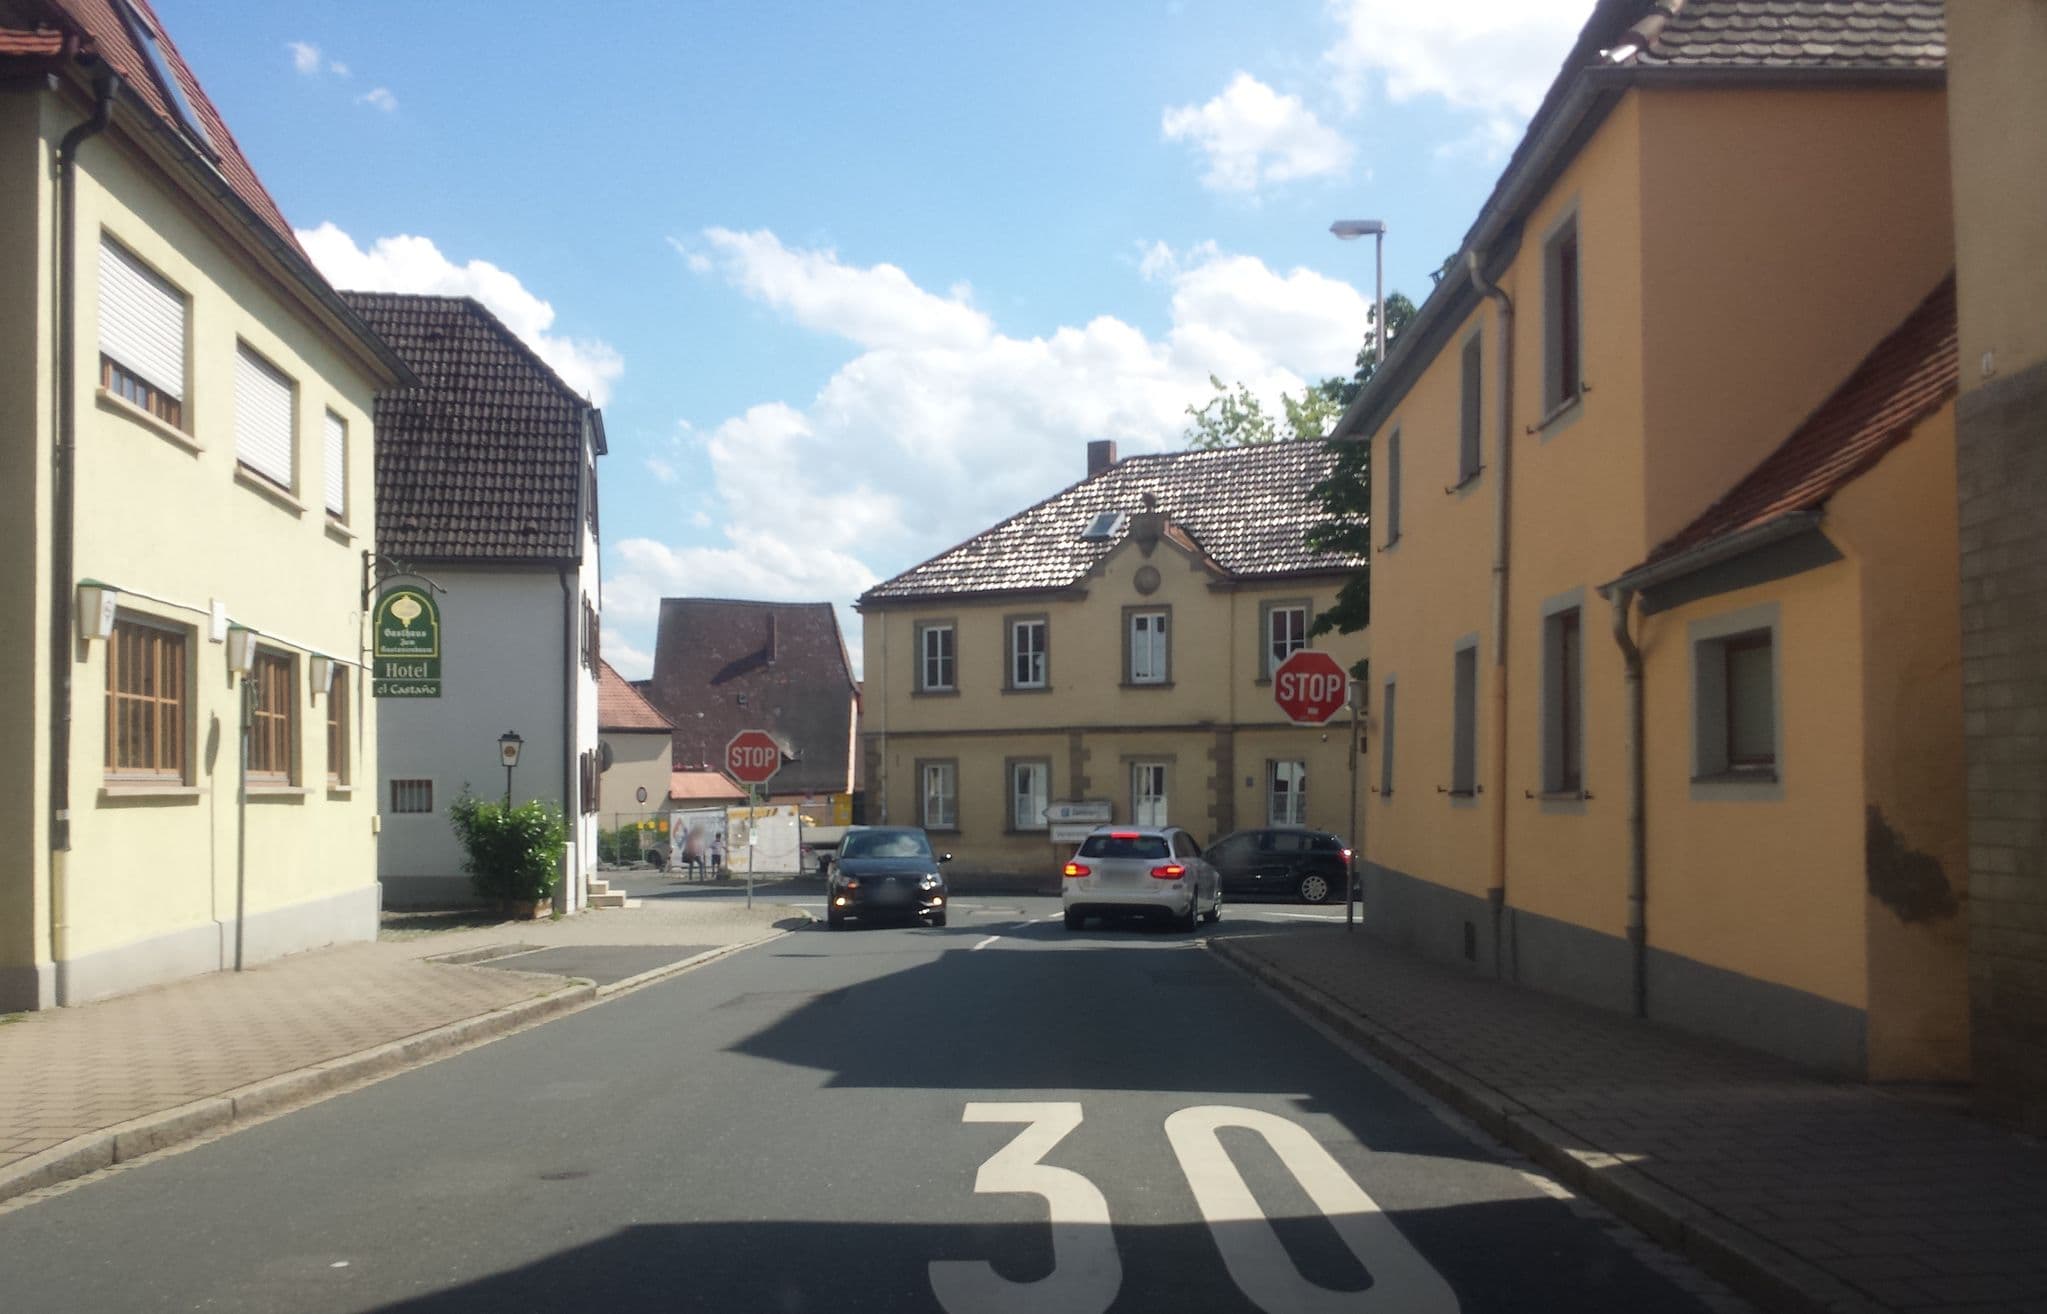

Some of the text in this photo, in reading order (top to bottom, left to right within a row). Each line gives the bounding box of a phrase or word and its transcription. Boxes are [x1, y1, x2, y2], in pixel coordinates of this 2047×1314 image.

[386, 662, 427, 677] Hotel
[377, 683, 436, 694] el Castaño
[1280, 672, 1341, 703] STOP
[732, 747, 775, 768] STOP
[928, 1102, 1461, 1314] 30
